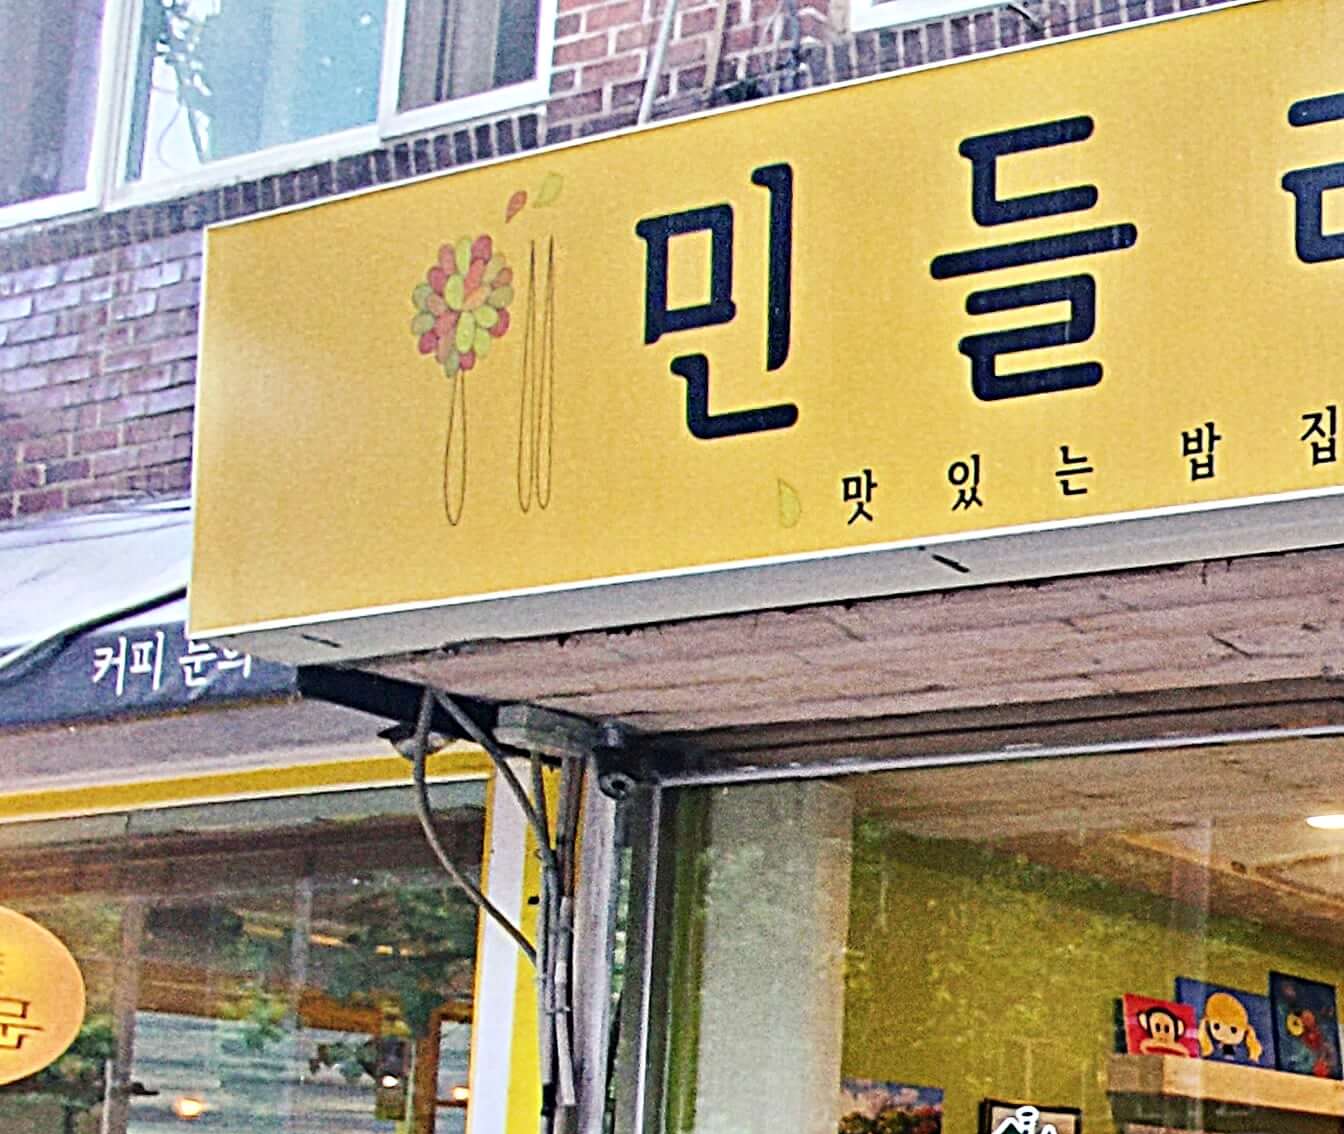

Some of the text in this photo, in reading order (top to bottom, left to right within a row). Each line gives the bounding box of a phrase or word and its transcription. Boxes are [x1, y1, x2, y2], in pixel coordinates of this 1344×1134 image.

[842, 405, 1337, 525] 맛있는 밥집
[93, 631, 164, 696] 커피
